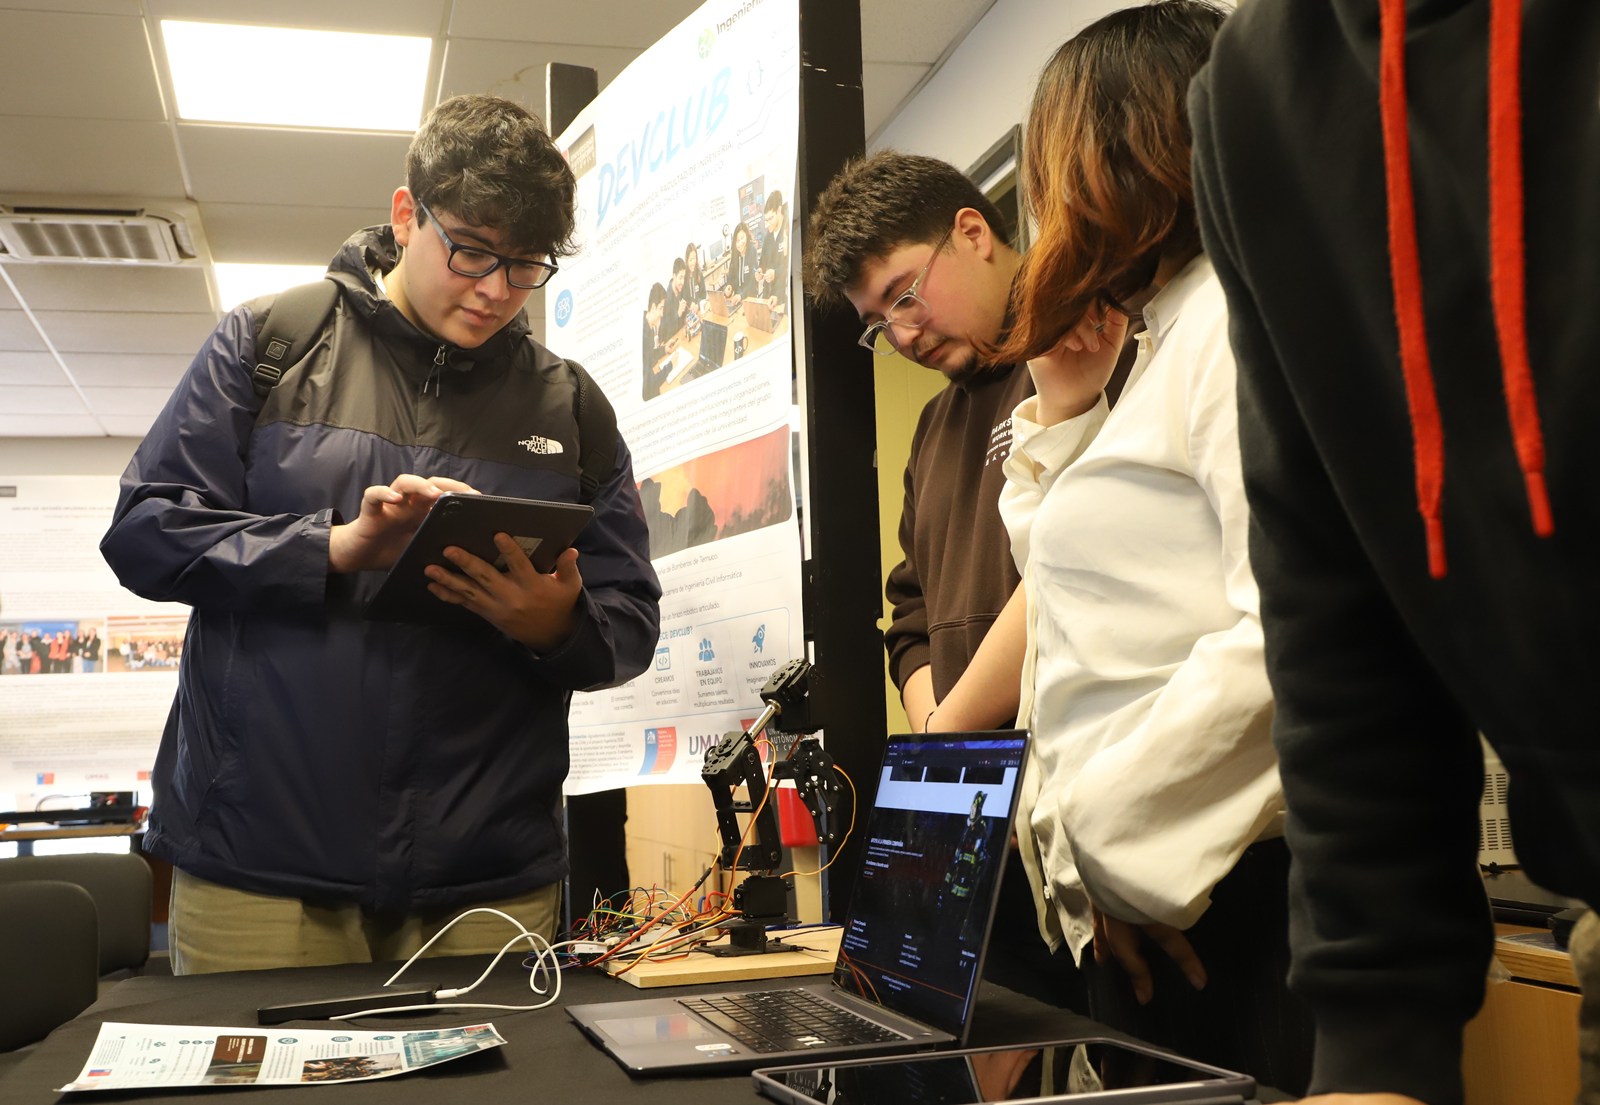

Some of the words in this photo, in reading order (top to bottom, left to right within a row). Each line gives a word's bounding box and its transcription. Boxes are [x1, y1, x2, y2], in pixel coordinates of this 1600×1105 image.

[716, 0, 763, 35] Ingenier
[596, 66, 732, 230] DEVCLUB
[530, 435, 547, 444] THE
[526, 444, 547, 455] FACE
[672, 560, 692, 572] Bomberos
[692, 558, 699, 566] de
[705, 575, 716, 586] Civil
[716, 570, 742, 583] Informática
[670, 625, 693, 638] DEVCLUB?
[748, 658, 777, 670] INNOVAMOS
[696, 666, 724, 678] TRABAJAMOS
[654, 674, 674, 684] CREAMOS
[700, 678, 706, 686] EN
[707, 676, 722, 686] EQUIPO
[689, 733, 727, 756] UMA
[770, 734, 798, 745] AUTÓNOM
